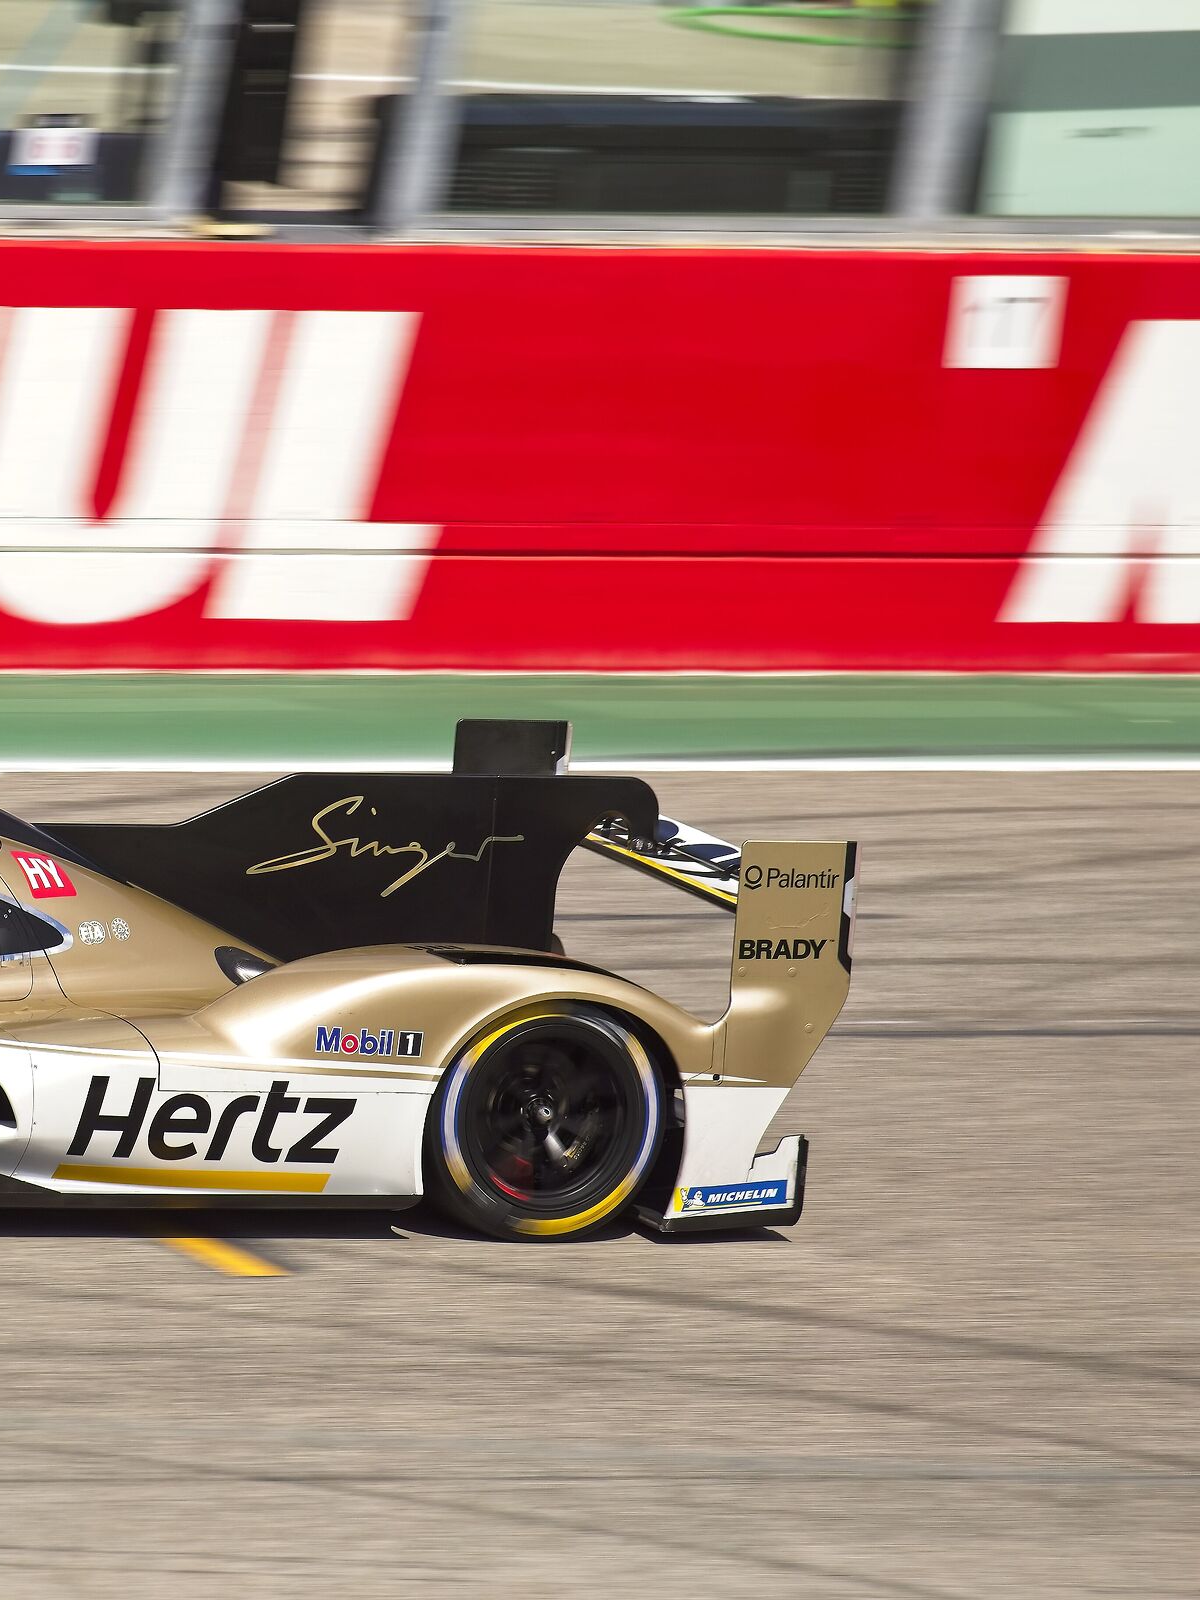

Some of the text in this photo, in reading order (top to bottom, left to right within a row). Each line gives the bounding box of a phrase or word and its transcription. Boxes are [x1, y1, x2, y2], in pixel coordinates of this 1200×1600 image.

[246, 796, 525, 898] Singer
[17, 857, 65, 889] HY
[766, 868, 840, 889] Palantir
[738, 939, 828, 960] BRADY
[315, 1026, 394, 1056] Mobil
[66, 1075, 358, 1163] Hertz
[706, 1187, 779, 1204] MICHELIN
